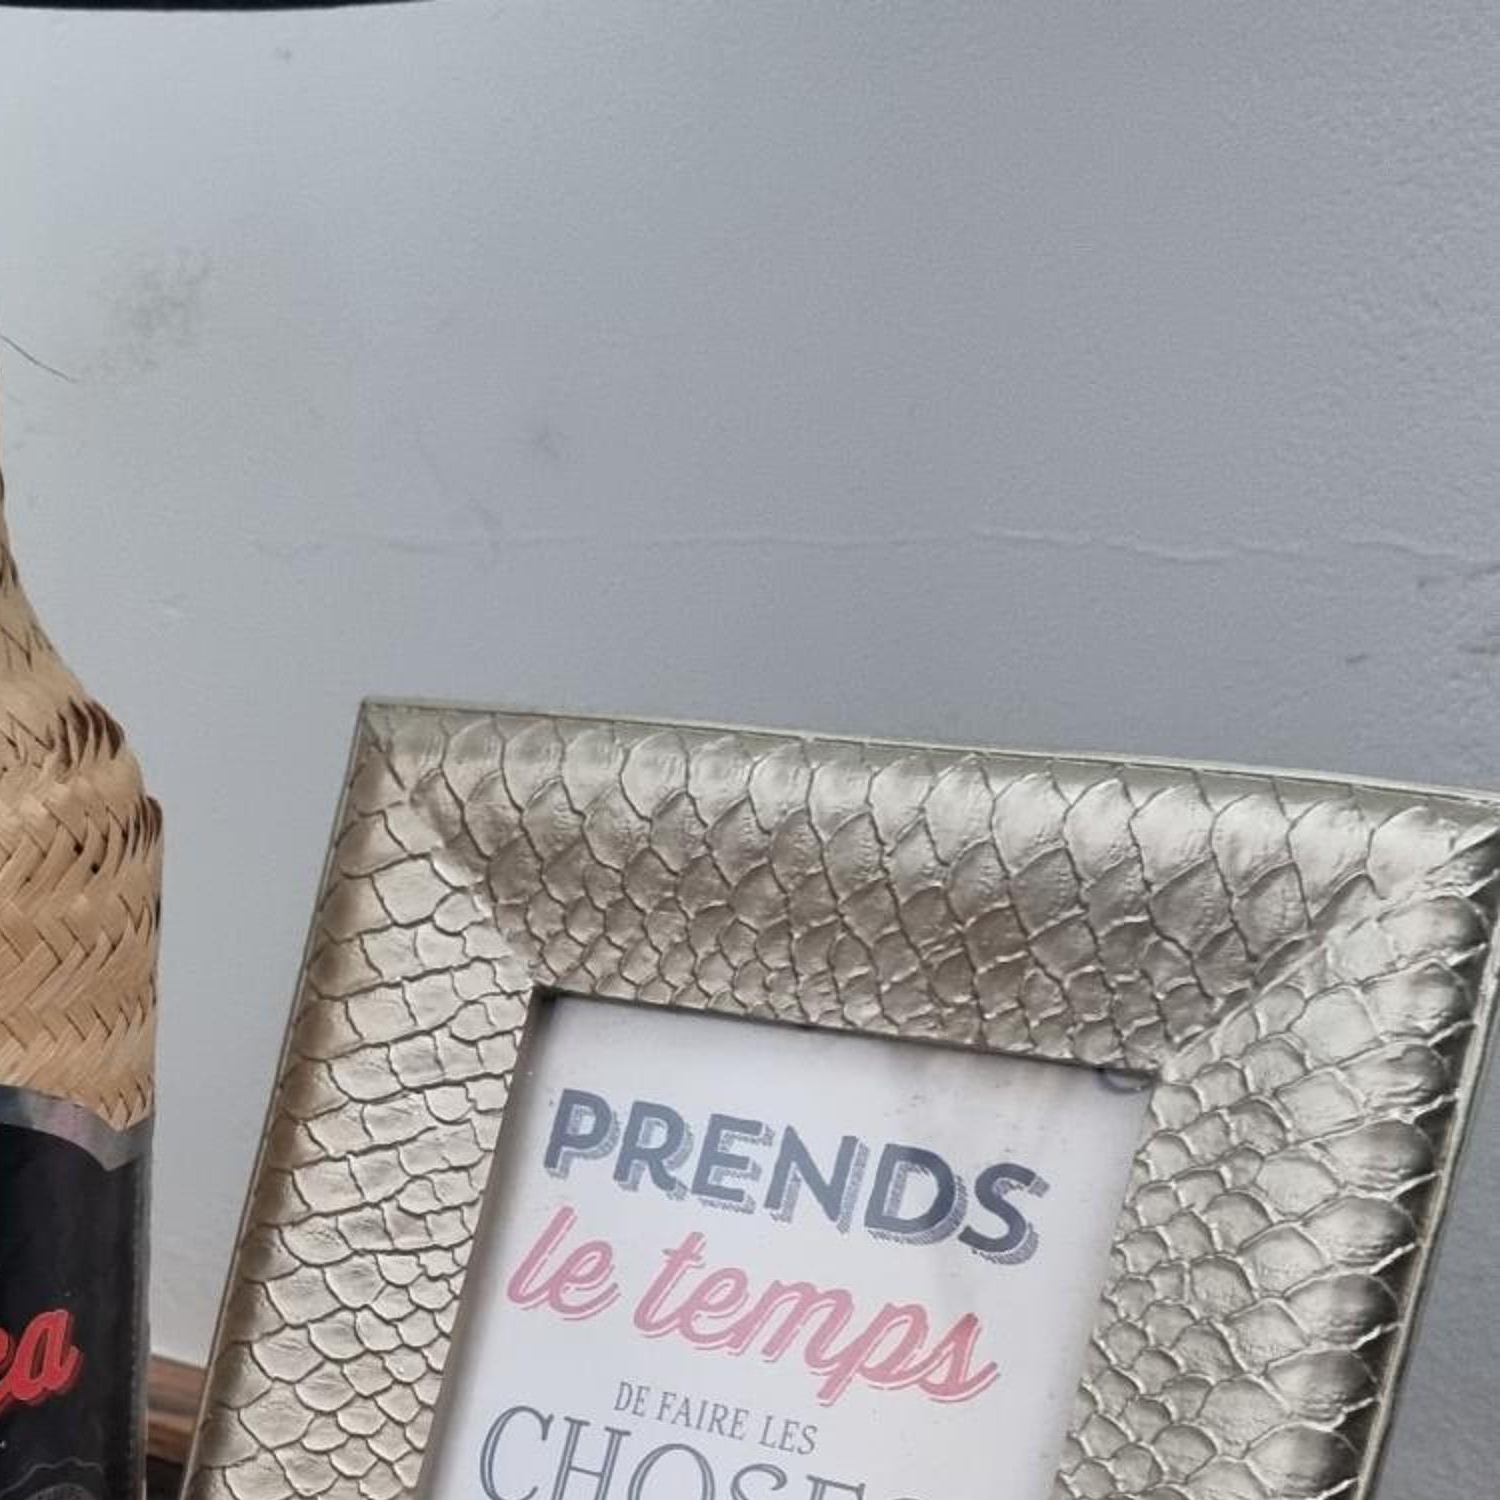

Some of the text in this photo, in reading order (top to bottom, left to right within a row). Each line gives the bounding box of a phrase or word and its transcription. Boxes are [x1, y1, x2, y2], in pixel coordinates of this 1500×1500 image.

[543, 1087, 1051, 1267] PRENDS
[505, 1204, 1001, 1407] le temps
[614, 1380, 820, 1457] DE FAIRE LES
